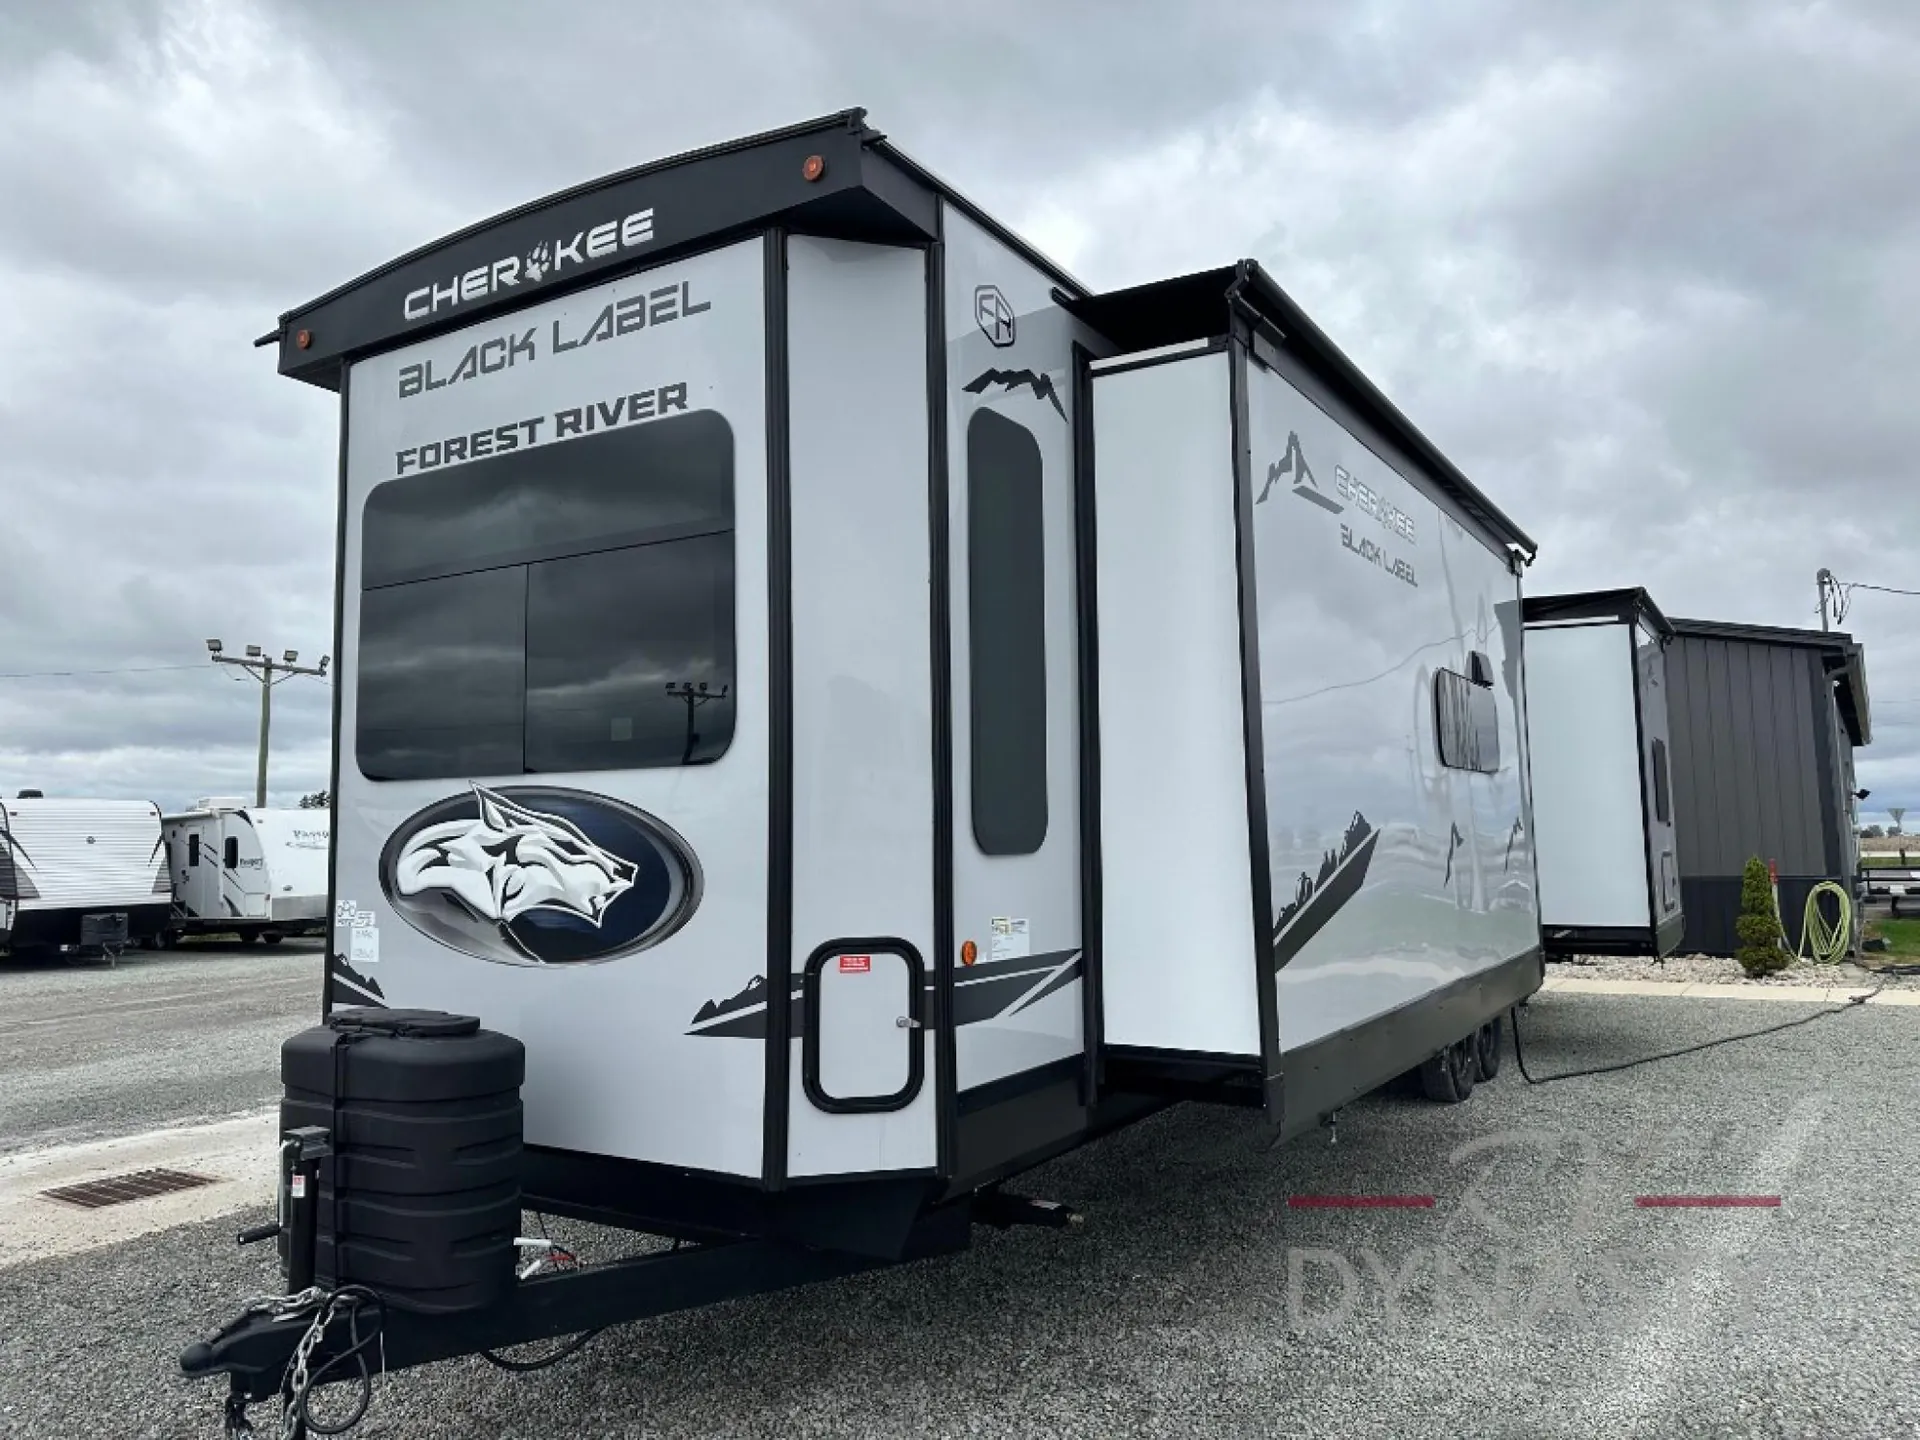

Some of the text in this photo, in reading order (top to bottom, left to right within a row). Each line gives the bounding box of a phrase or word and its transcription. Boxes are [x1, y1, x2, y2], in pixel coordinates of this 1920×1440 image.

[399, 281, 711, 399] BLACK LABEL
[396, 383, 688, 475] FOREST RIVER
[1340, 523, 1418, 588] BLACK LABEL
